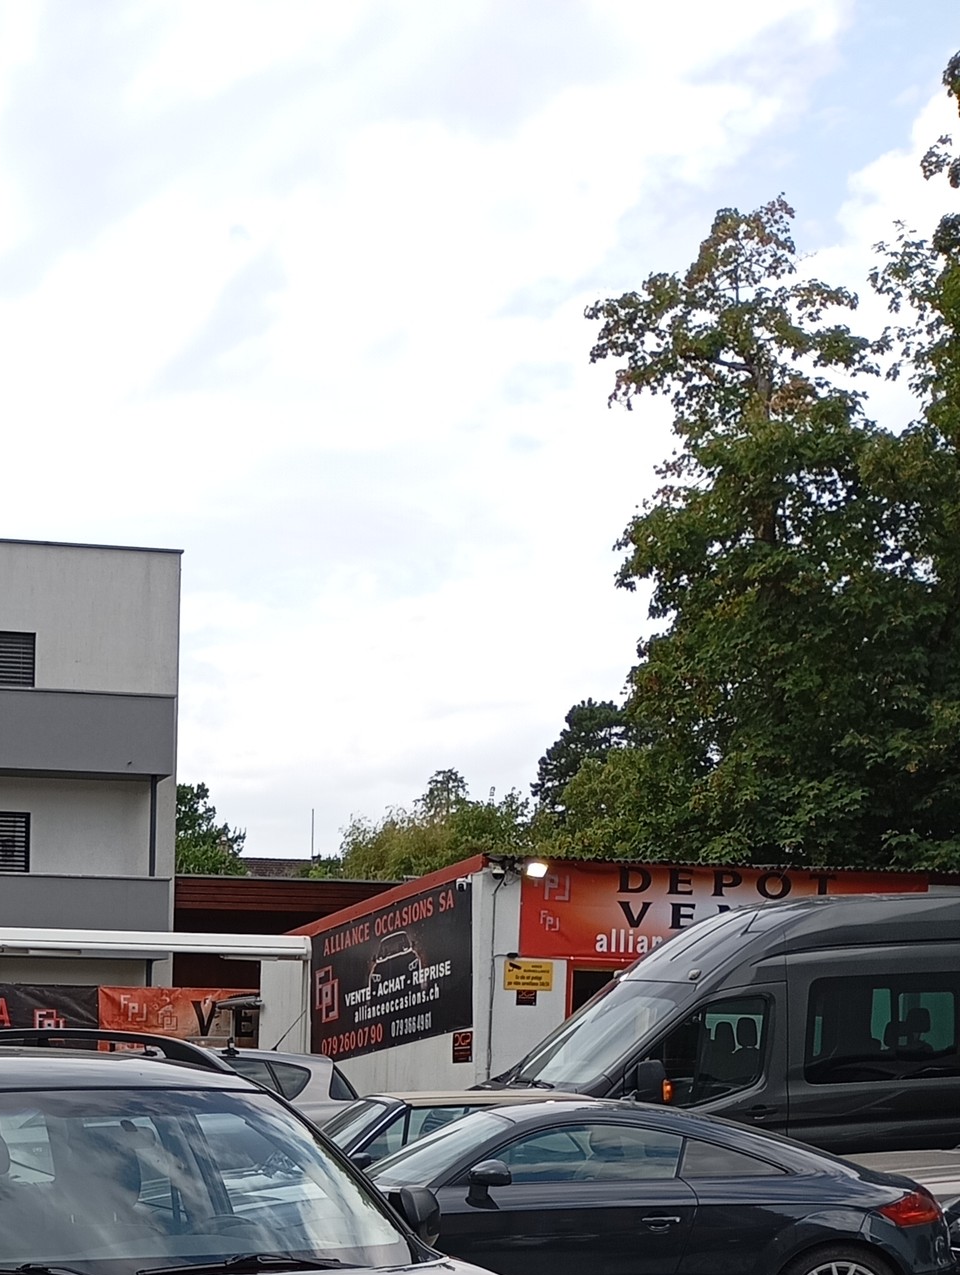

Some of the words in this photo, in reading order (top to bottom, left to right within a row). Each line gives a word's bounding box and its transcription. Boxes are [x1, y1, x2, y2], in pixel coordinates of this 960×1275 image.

[323, 923, 370, 957] ALLIANCE
[374, 897, 433, 937] OCCASIONS
[439, 889, 454, 913] SA
[344, 986, 371, 1007] VENTE
[377, 975, 406, 997] ACHAT
[412, 960, 451, 986] REPRISE
[354, 983, 440, 1023] allianceoccasions.ch
